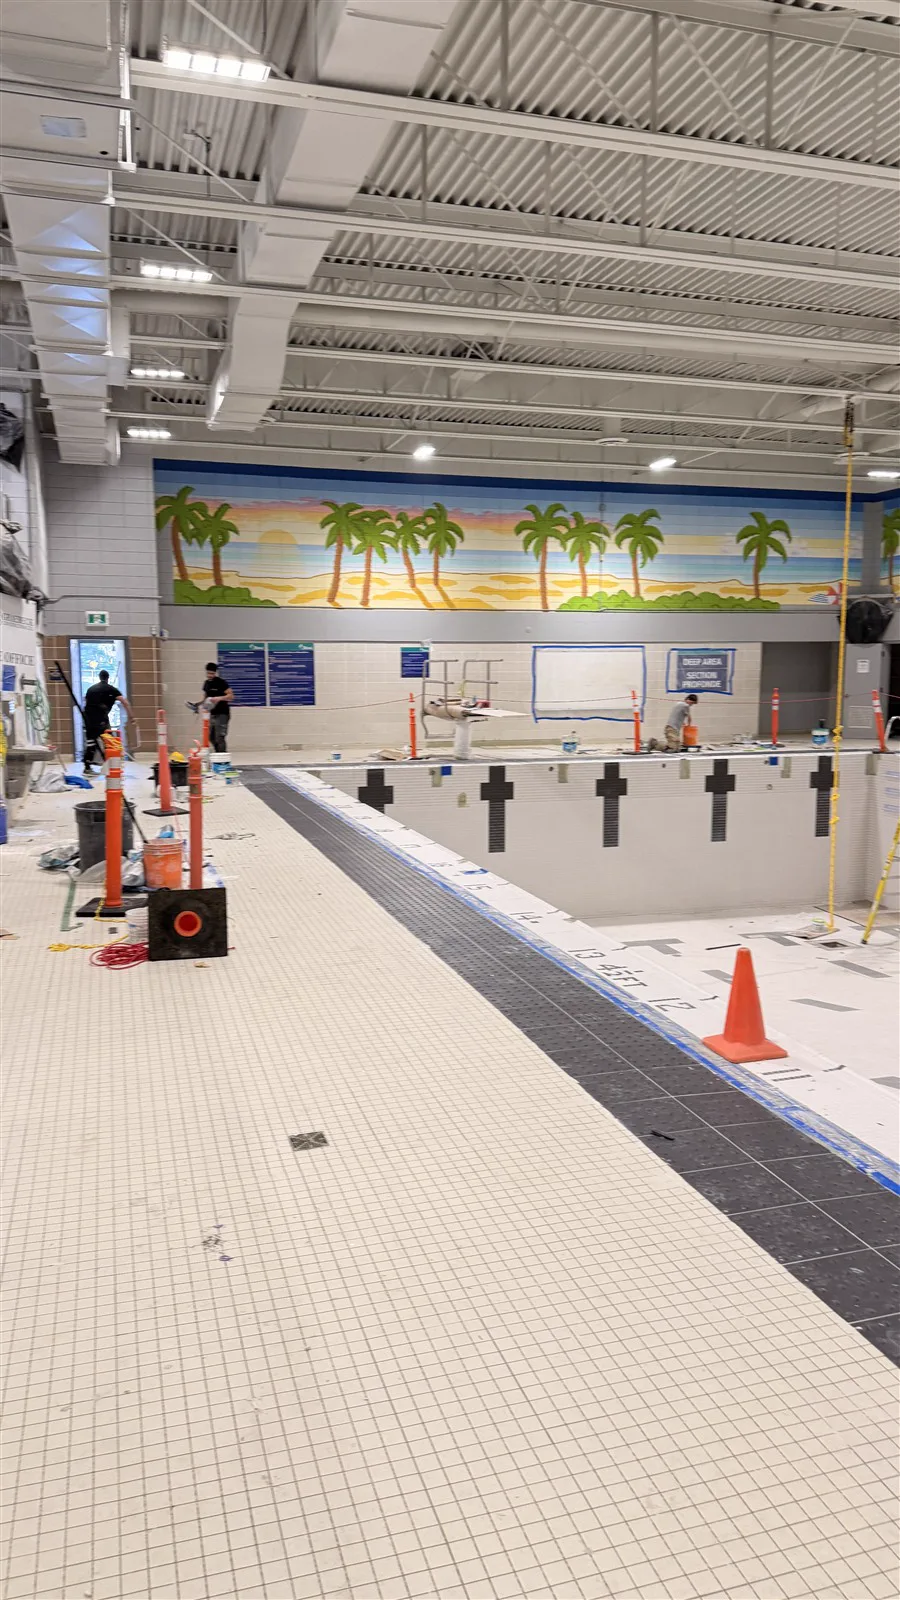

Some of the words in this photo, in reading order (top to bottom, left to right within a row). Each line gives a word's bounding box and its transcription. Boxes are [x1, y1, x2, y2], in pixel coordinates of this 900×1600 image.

[3, 651, 35, 666] OFFICE
[682, 658, 702, 666] DEEP
[702, 658, 722, 666] AREA
[686, 671, 718, 679] SECTION
[681, 680, 722, 688] PROFONDE
[568, 948, 606, 959] 13
[648, 997, 697, 1012] 12
